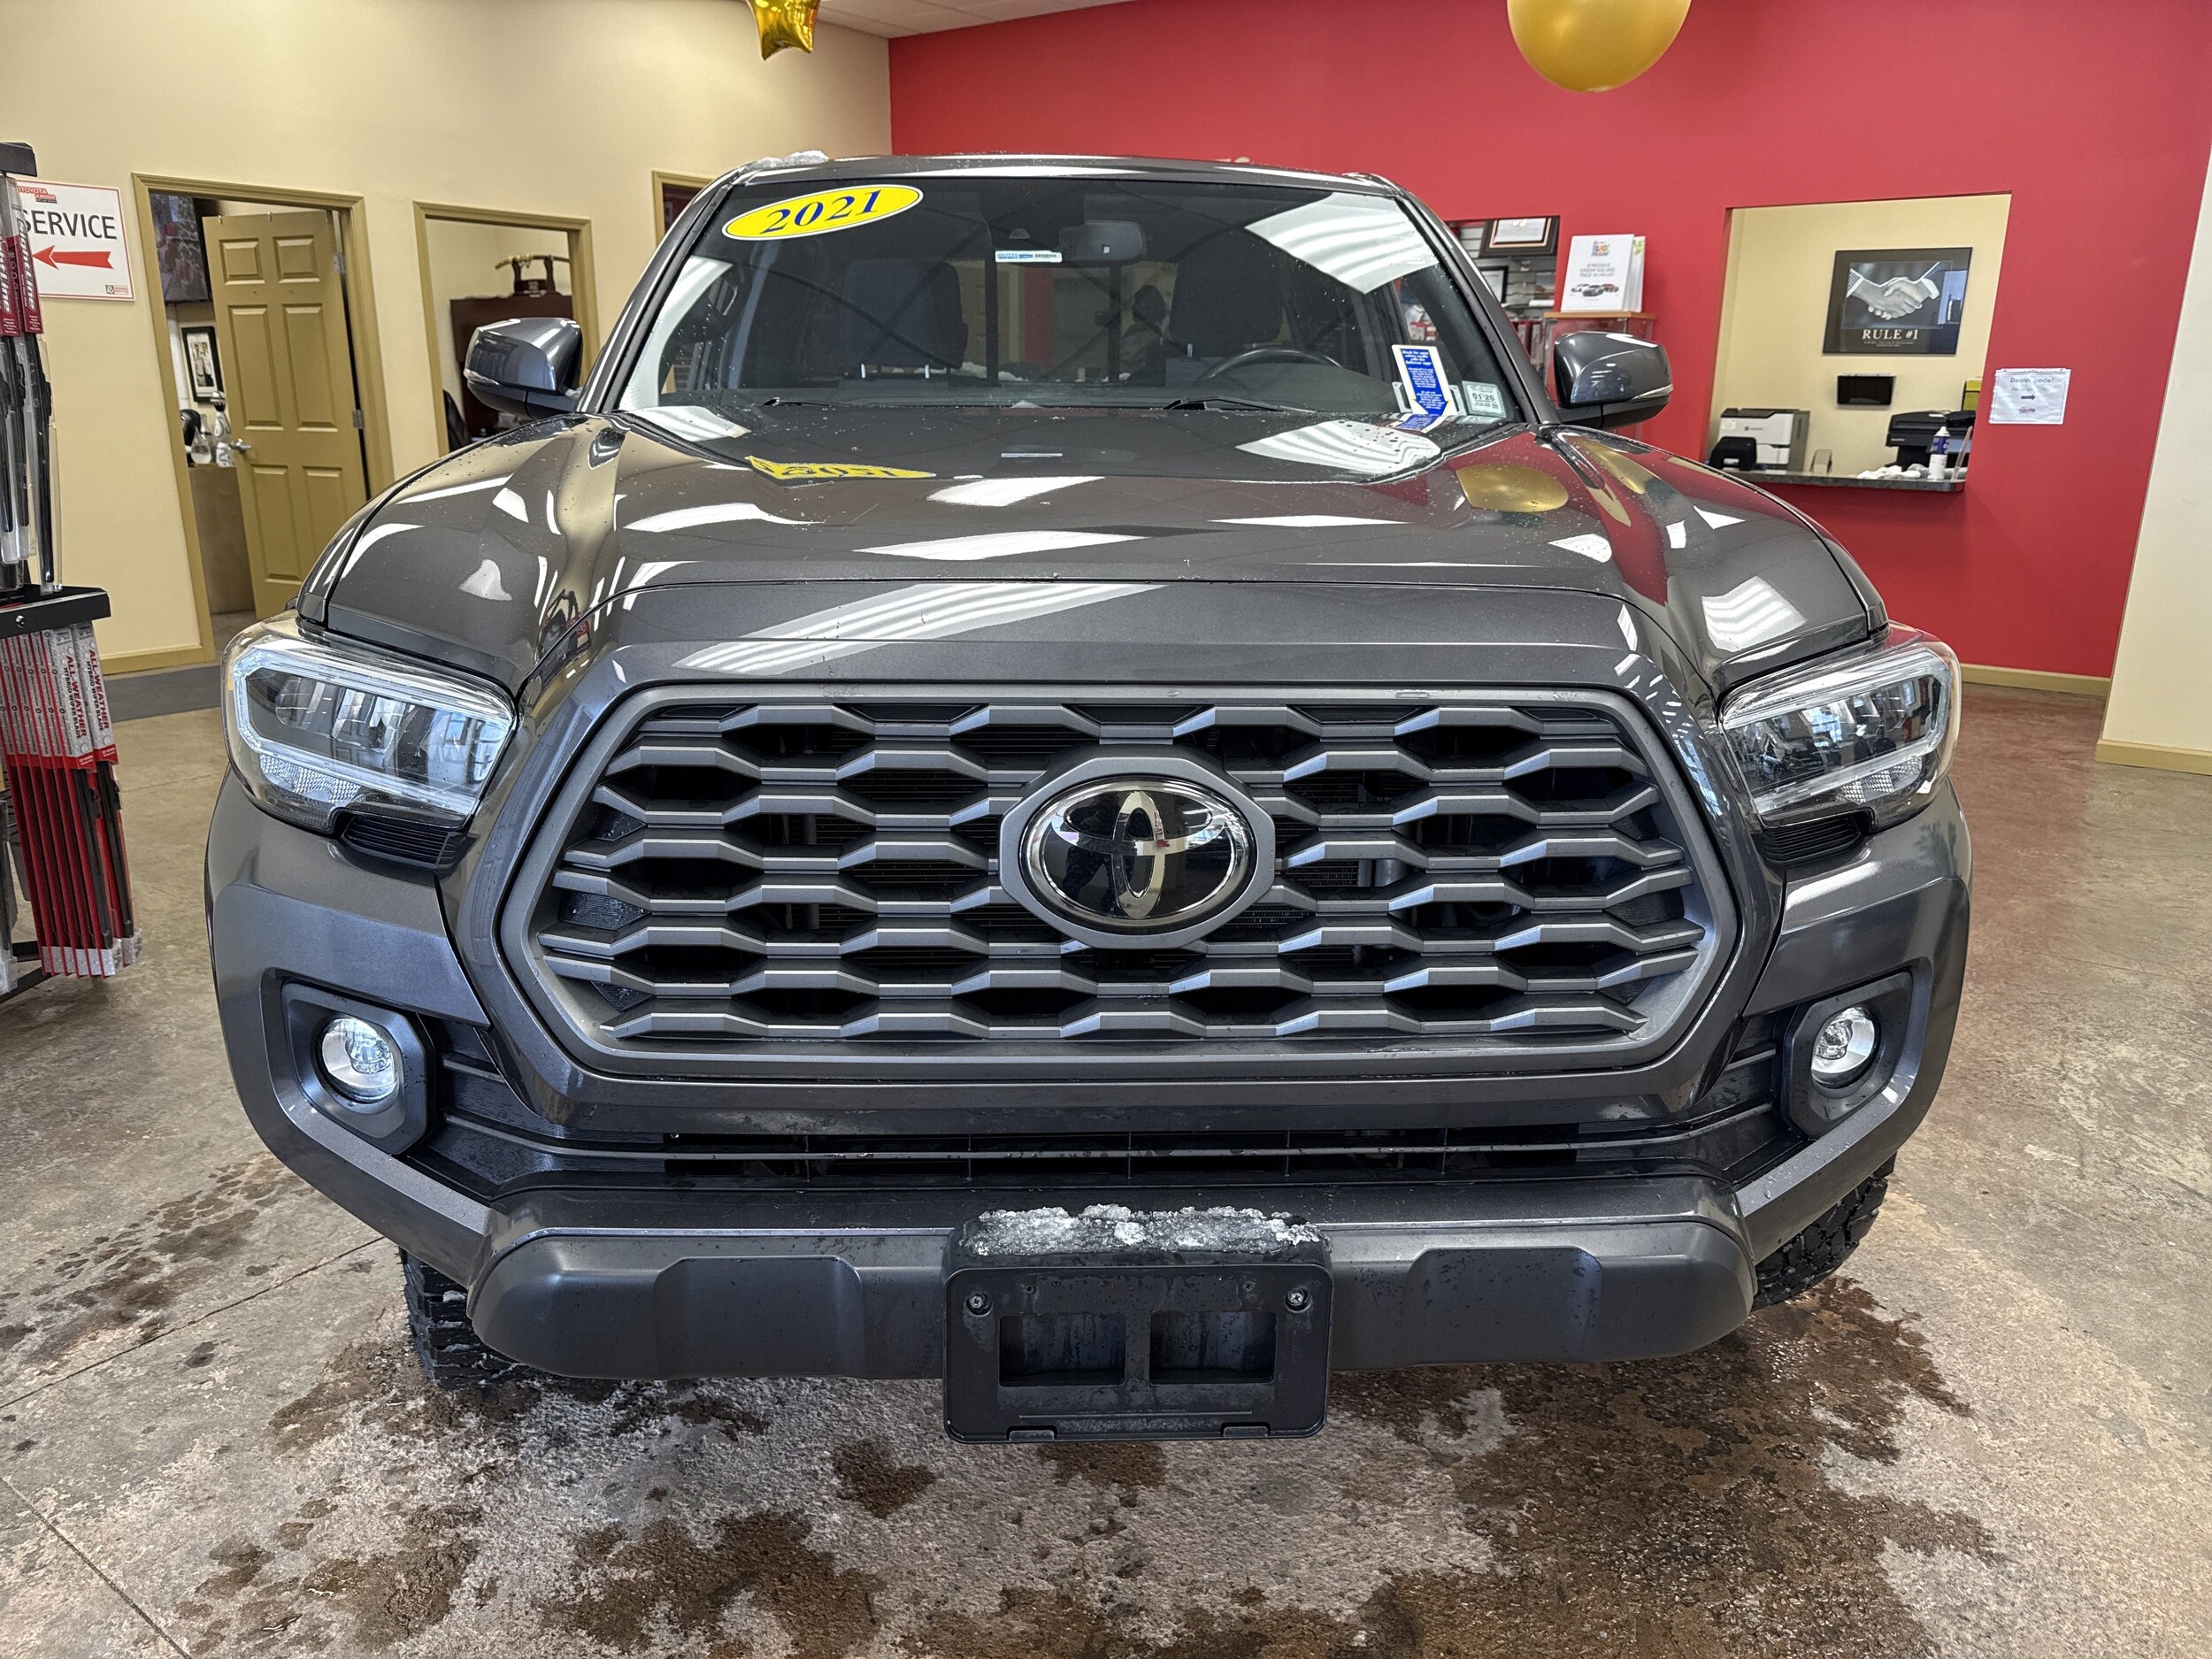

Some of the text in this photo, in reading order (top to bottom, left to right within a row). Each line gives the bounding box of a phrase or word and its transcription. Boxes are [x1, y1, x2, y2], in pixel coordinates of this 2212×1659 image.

[759, 189, 882, 235] 2021
[1862, 329, 1918, 340] RULE #1
[66, 656, 88, 738] ALL-WEATHER
[88, 649, 110, 730] ALL-WEATHER
[96, 710, 104, 732] BLADE
